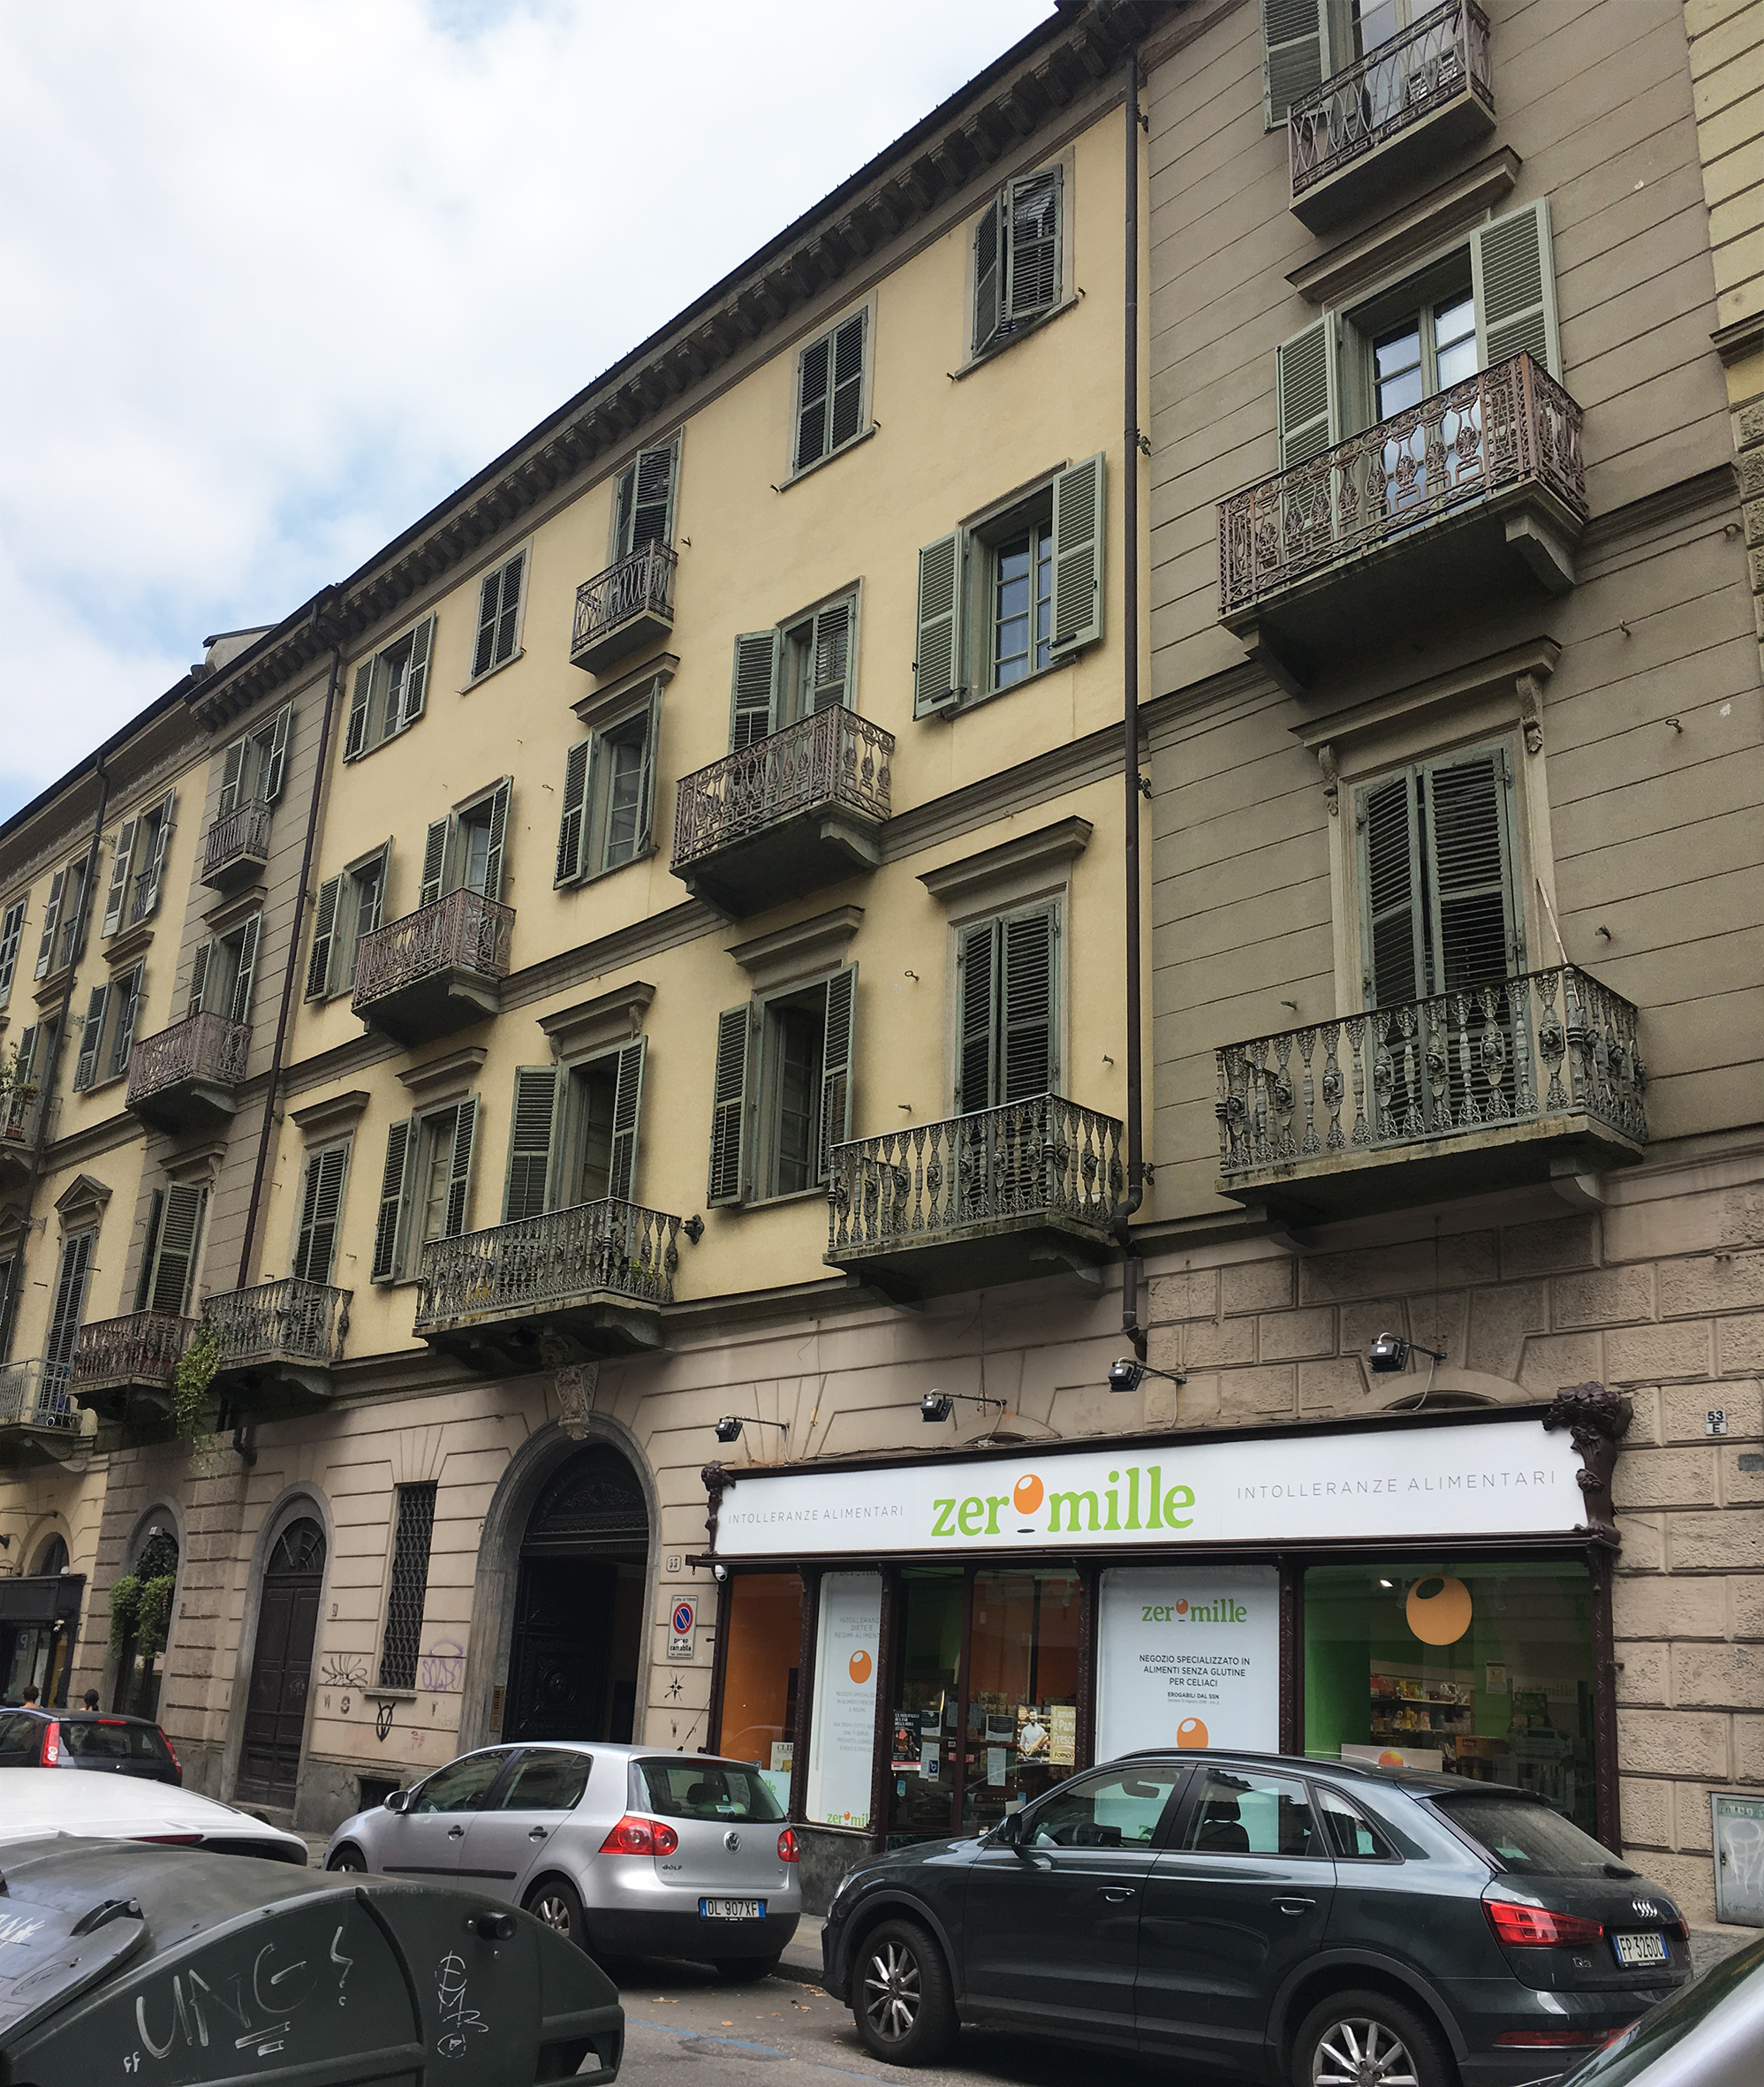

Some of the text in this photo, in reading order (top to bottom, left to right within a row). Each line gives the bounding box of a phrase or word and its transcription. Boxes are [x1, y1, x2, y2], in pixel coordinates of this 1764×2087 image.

[1707, 1410, 1723, 1421] 53
[1712, 1423, 1721, 1433] E
[1237, 1469, 1556, 1499] INTOLLERANZE ALIMENTARI
[728, 1505, 905, 1524] INTOLLERANZE ALIMENTARI
[1177, 1656, 1239, 1666] SPECIALIZZATO
[1143, 1666, 1245, 1677] ALIMENTI SENZA GLUTINE
[1170, 1677, 1218, 1687] PER CELIACI
[708, 1900, 757, 1916] DL 907XF
[1618, 1935, 1664, 1961] FP 326DC
[1572, 1956, 1593, 1969] Q3
